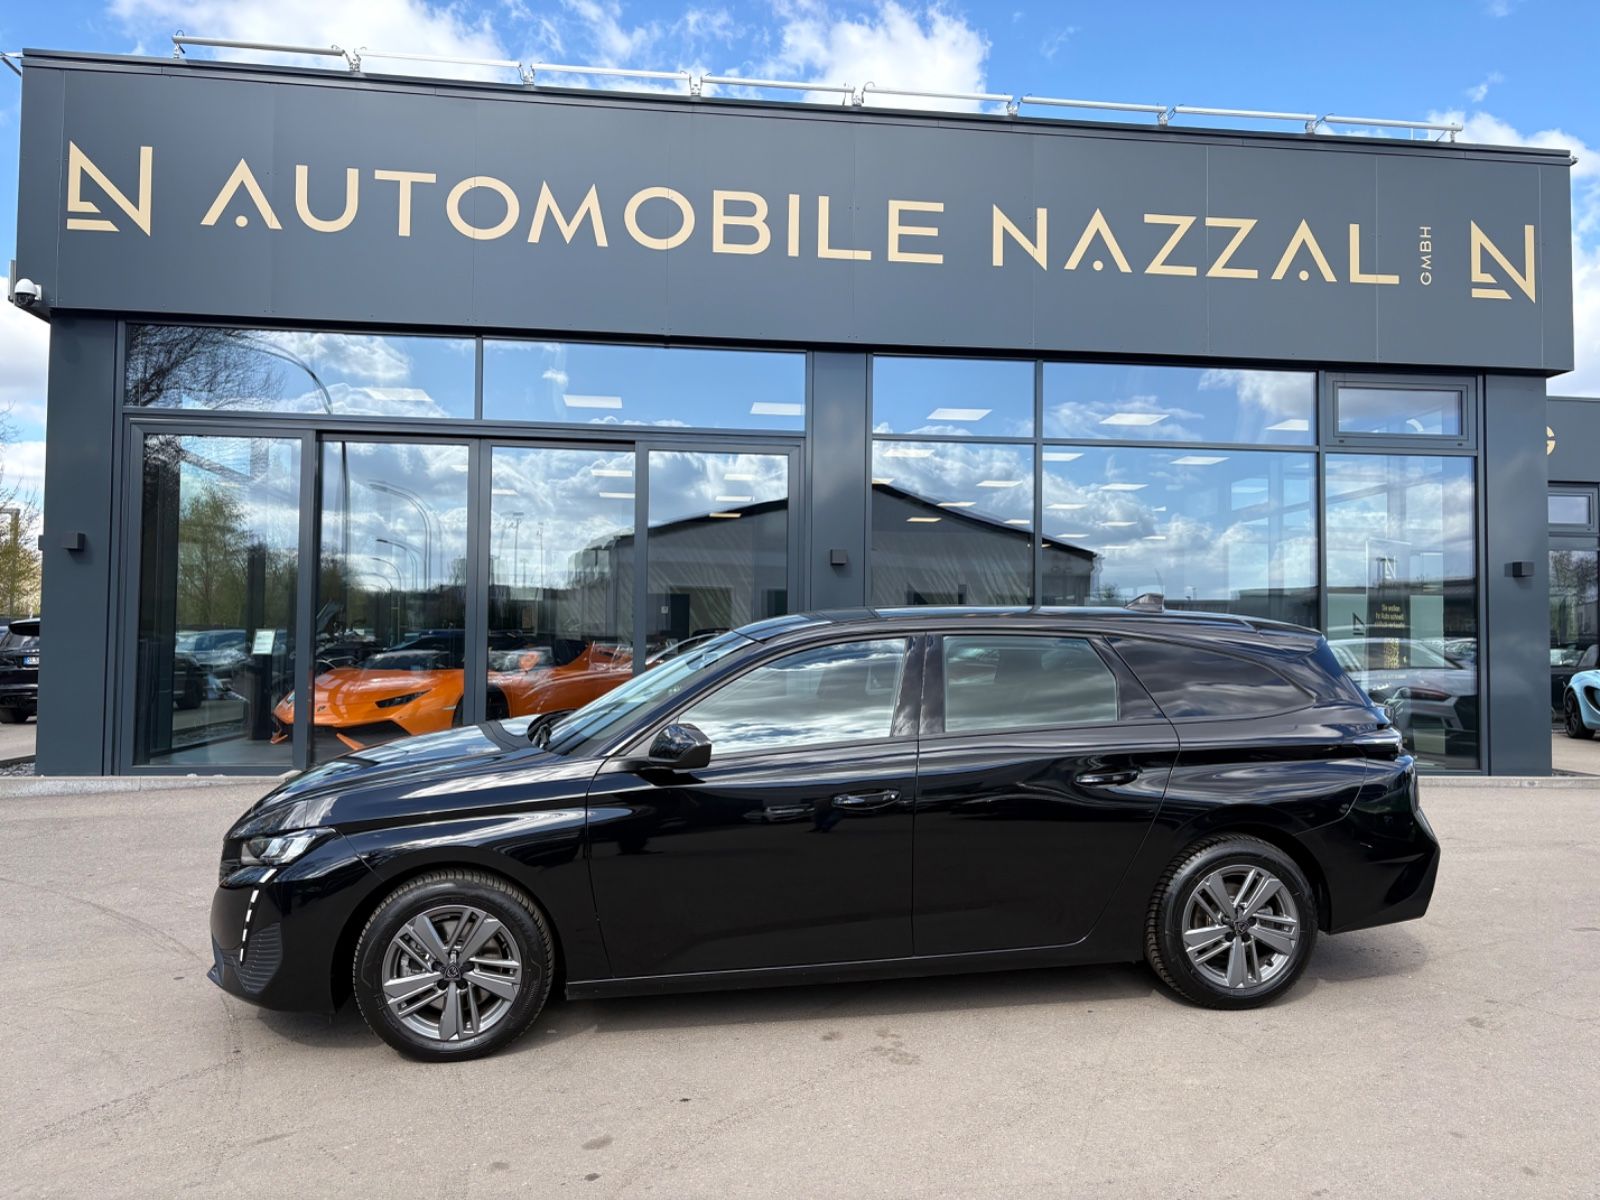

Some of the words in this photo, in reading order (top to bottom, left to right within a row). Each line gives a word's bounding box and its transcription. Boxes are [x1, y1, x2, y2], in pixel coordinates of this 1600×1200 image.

[202, 159, 945, 265] AUTOMOBILE
[992, 207, 1400, 285] NAZZAL
[1419, 225, 1432, 286] GMBH
